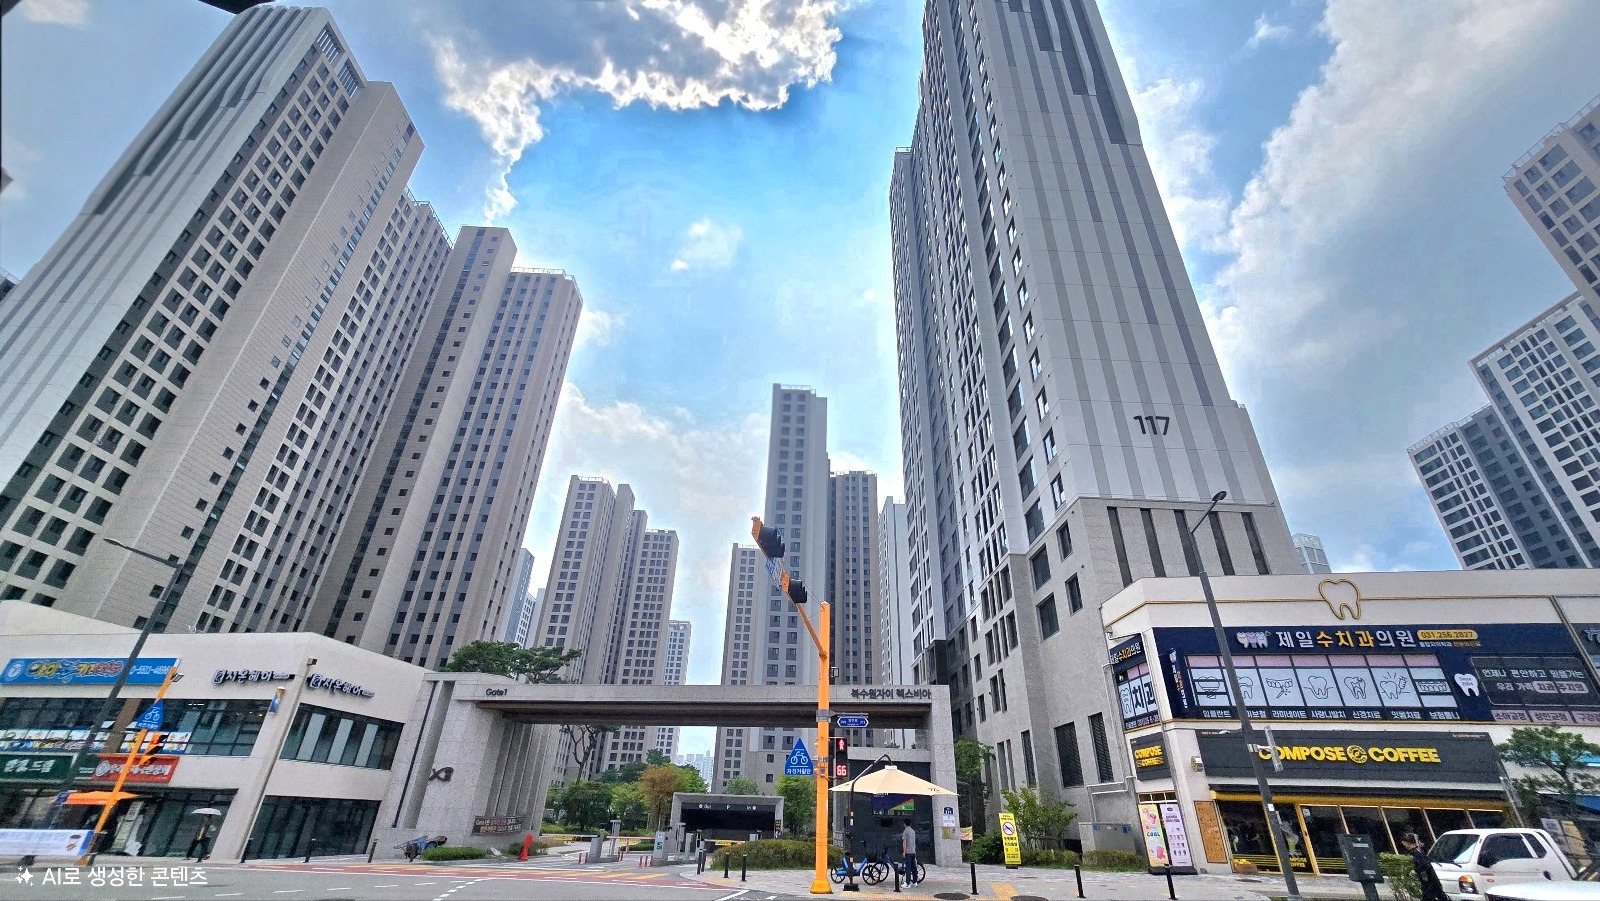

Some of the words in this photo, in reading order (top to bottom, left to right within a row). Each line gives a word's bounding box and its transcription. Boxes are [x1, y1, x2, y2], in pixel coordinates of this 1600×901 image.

[1133, 415, 1170, 435] 117
[1275, 629, 1417, 648] 제일수치과의원
[1420, 631, 1474, 639] 031.256.2827
[1482, 669, 1506, 678] 언제나
[1511, 669, 1547, 678] 편안하고
[1496, 682, 1514, 691] 우리
[1537, 682, 1556, 691] 치과
[1559, 682, 1584, 691] 주치의
[1132, 681, 1156, 708] 치과
[1203, 710, 1232, 718] 임플란트
[1272, 710, 1307, 719] 라미네이트
[1311, 710, 1346, 719] 사랑니발치
[1352, 710, 1382, 719] 신경치료
[1391, 711, 1422, 719] 잇몸치료
[1494, 712, 1526, 720] 소아교정
[1535, 713, 1567, 721] 성인교정
[1258, 745, 1348, 762] COMPOSE
[1368, 747, 1441, 763] COFFEE
[836, 765, 847, 776] 66
